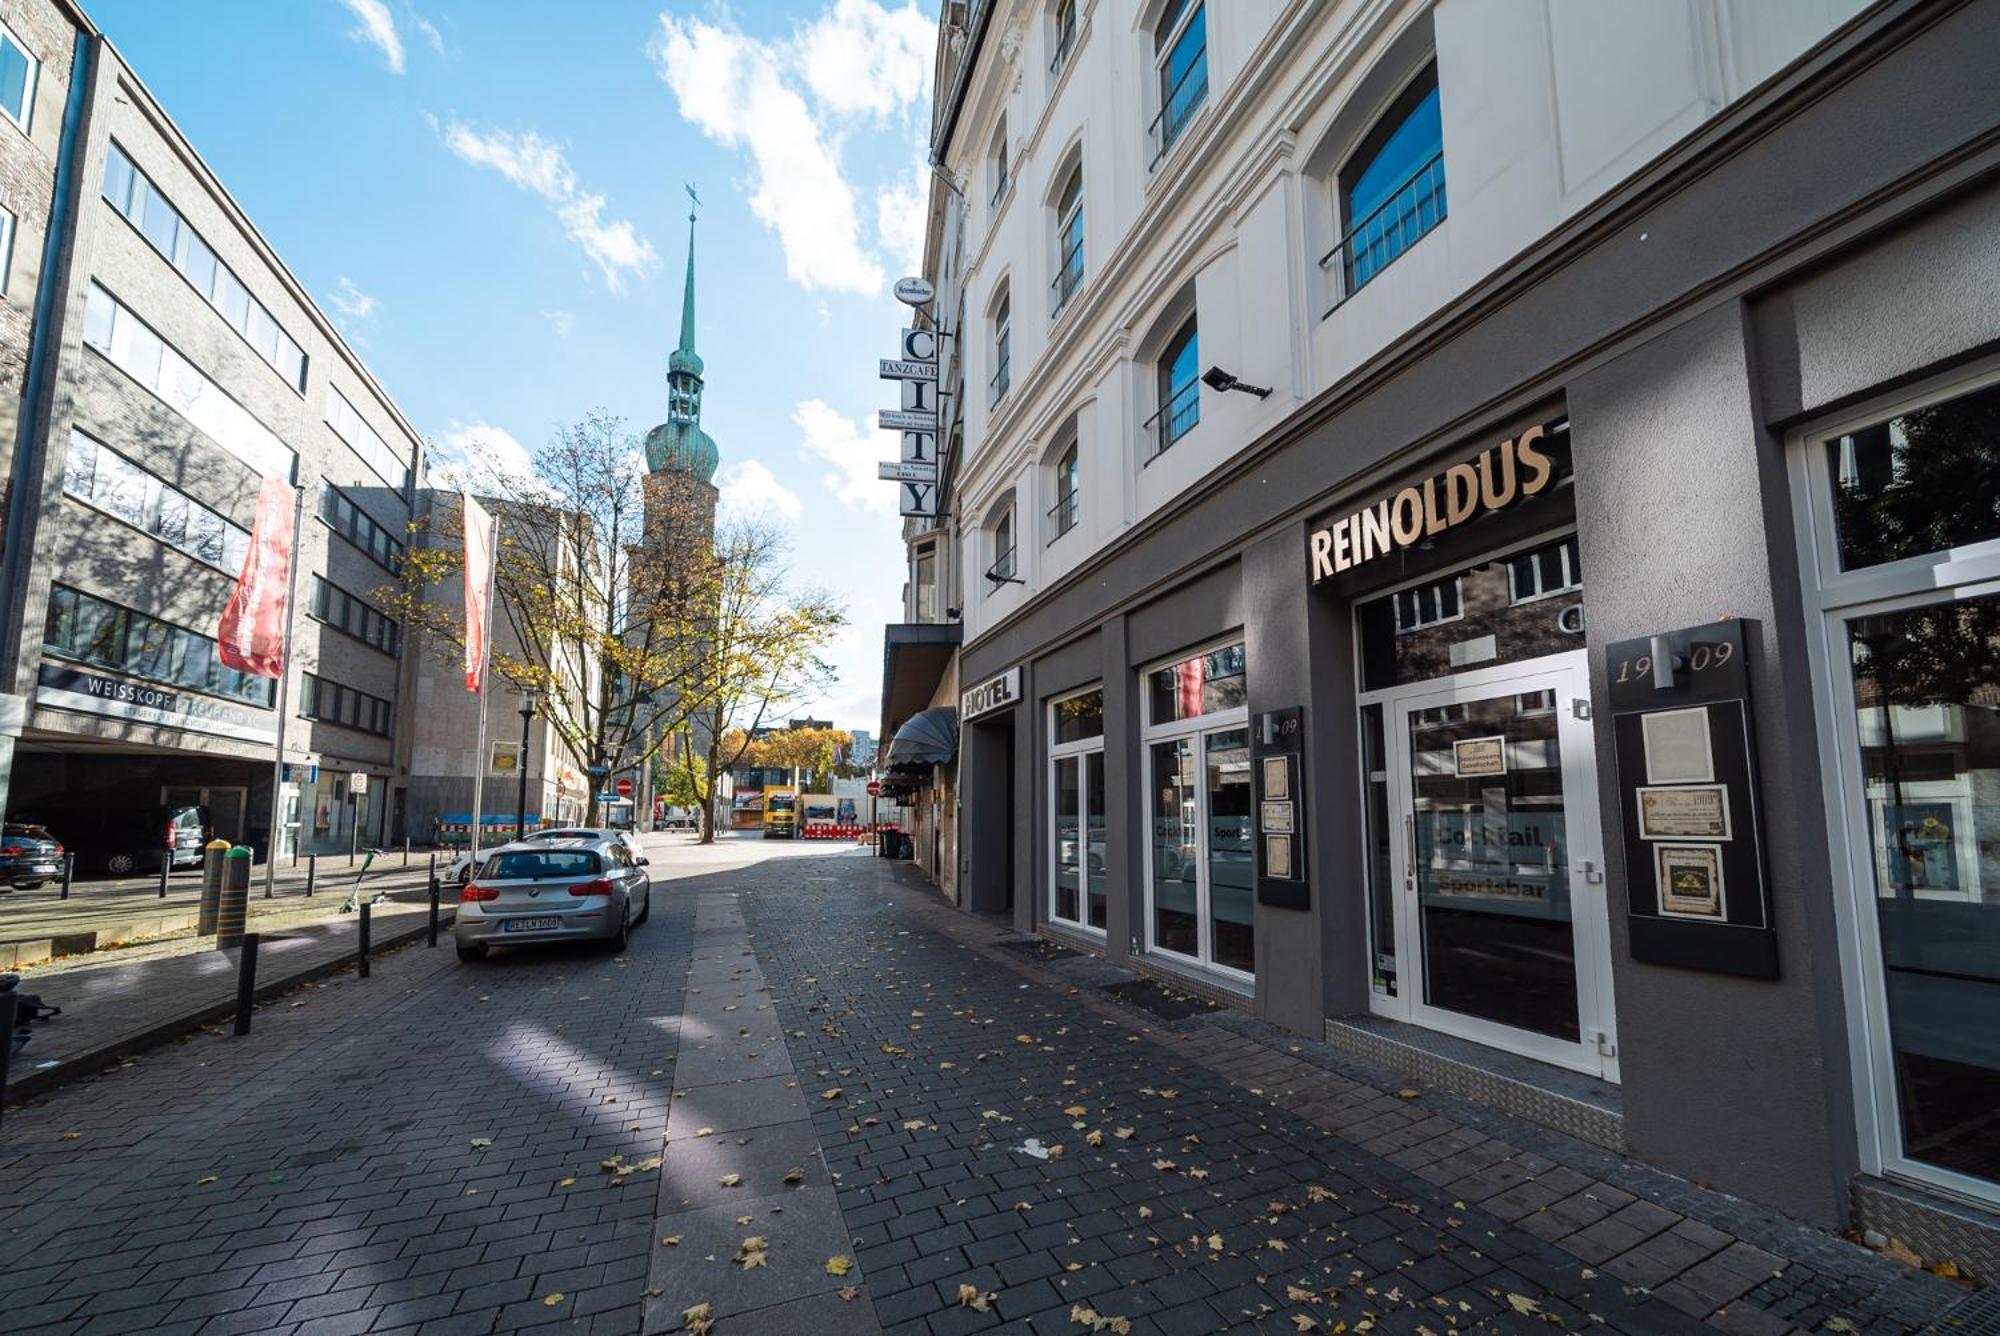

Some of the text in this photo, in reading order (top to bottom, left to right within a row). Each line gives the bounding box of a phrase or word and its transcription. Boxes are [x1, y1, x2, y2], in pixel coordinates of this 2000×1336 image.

[1311, 425, 1551, 581] REINOLDUS
[1616, 642, 1733, 683] 19 09
[88, 677, 171, 708] WEISSKOPF
[965, 676, 1012, 717] HOTEL
[1438, 875, 1547, 898] Sportsbar
